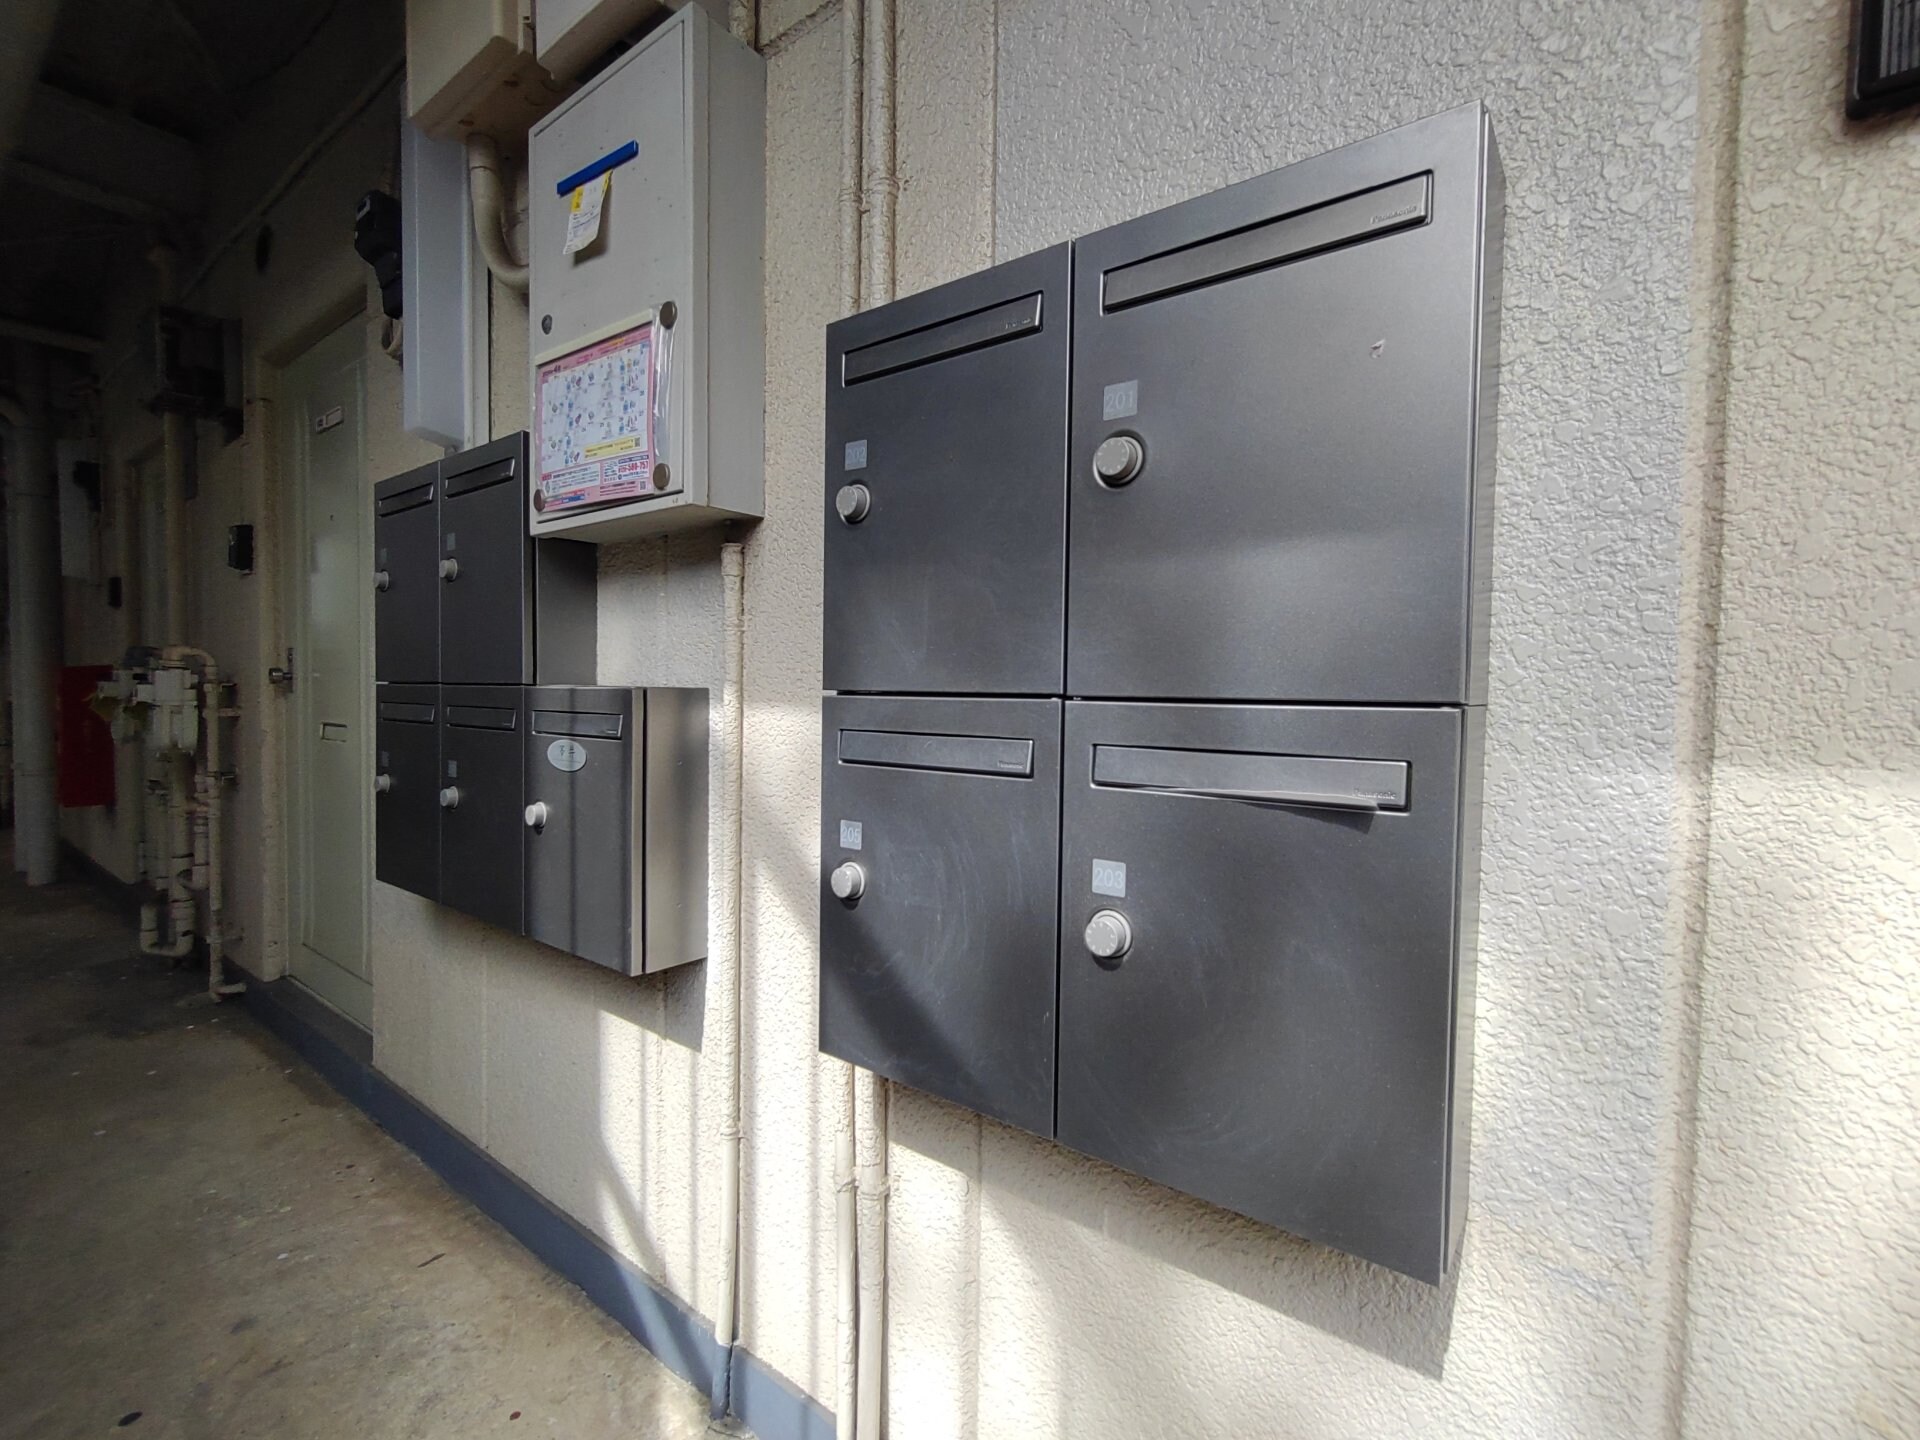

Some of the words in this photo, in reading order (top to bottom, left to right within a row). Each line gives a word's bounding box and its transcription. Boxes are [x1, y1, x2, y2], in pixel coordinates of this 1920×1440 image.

[1106, 390, 1134, 412] 201
[841, 825, 860, 843] 205
[1095, 867, 1123, 889] 203
